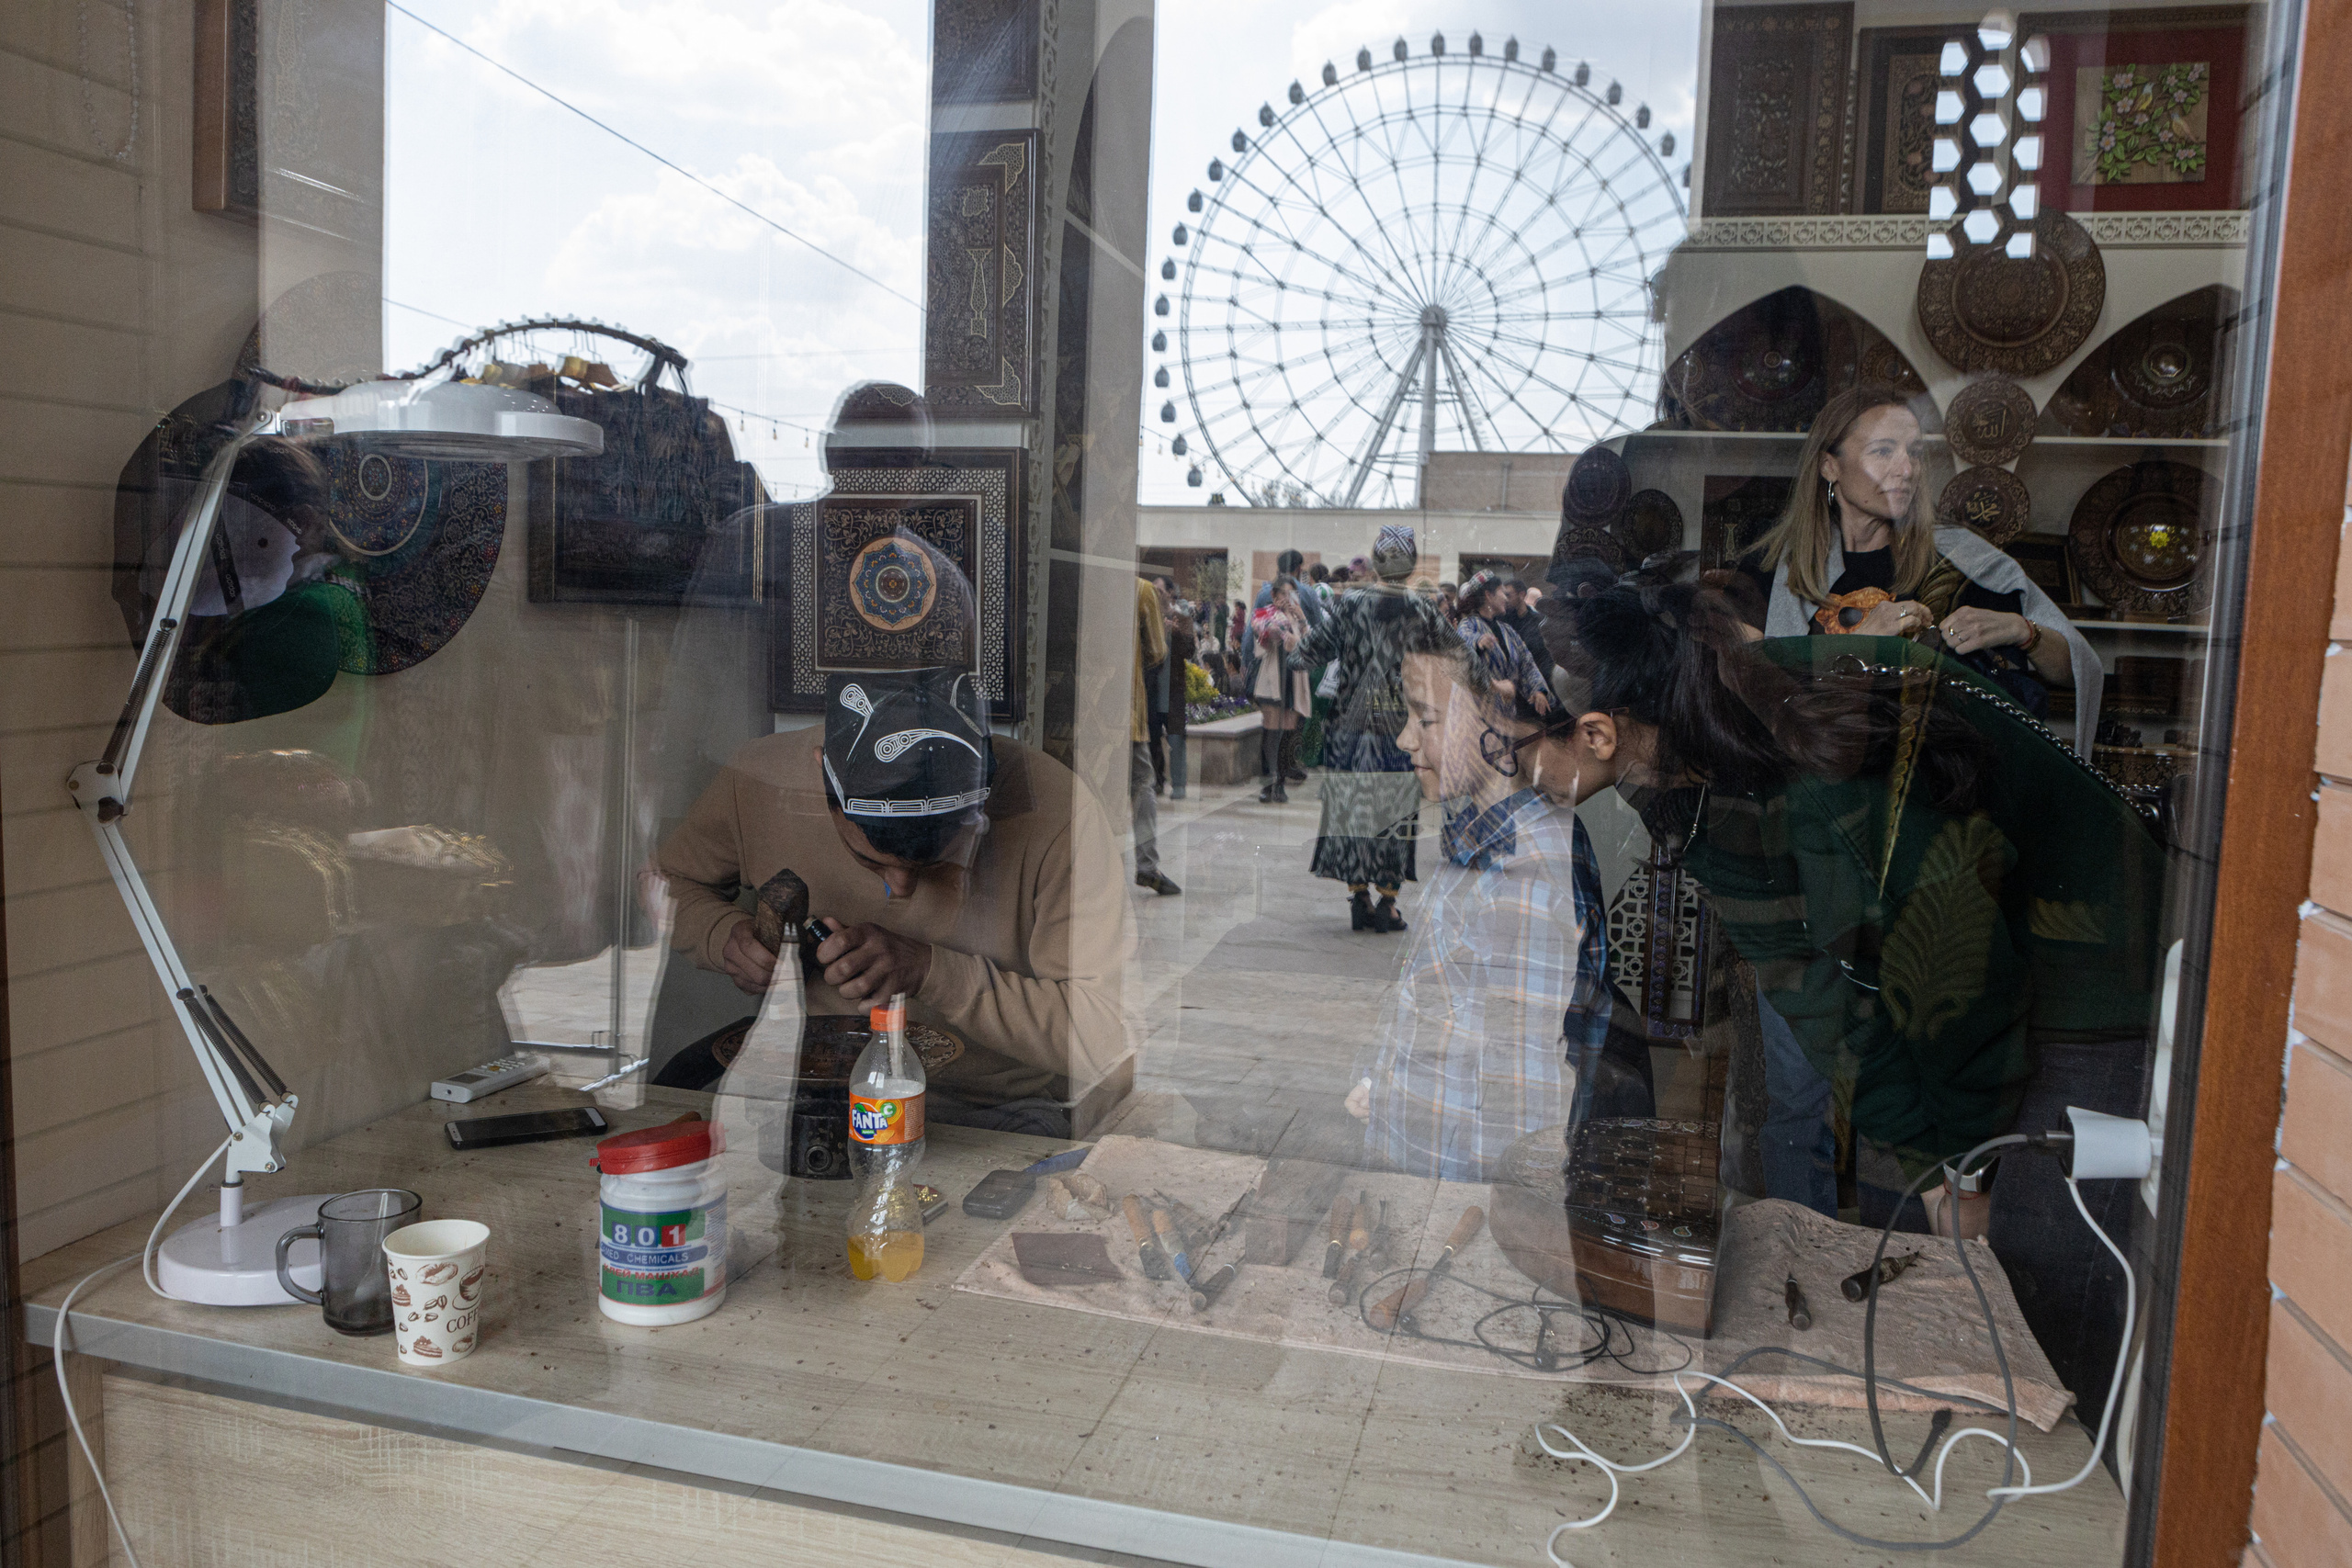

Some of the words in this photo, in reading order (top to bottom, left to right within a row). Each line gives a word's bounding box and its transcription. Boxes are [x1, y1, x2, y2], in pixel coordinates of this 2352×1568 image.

[852, 1108, 888, 1130] FANTA
[627, 1252, 689, 1265] CHEMICALS
[603, 1263, 631, 1279] КЛЕЙ
[635, 1267, 700, 1281] МАШХАД
[616, 1280, 678, 1297] ПВА
